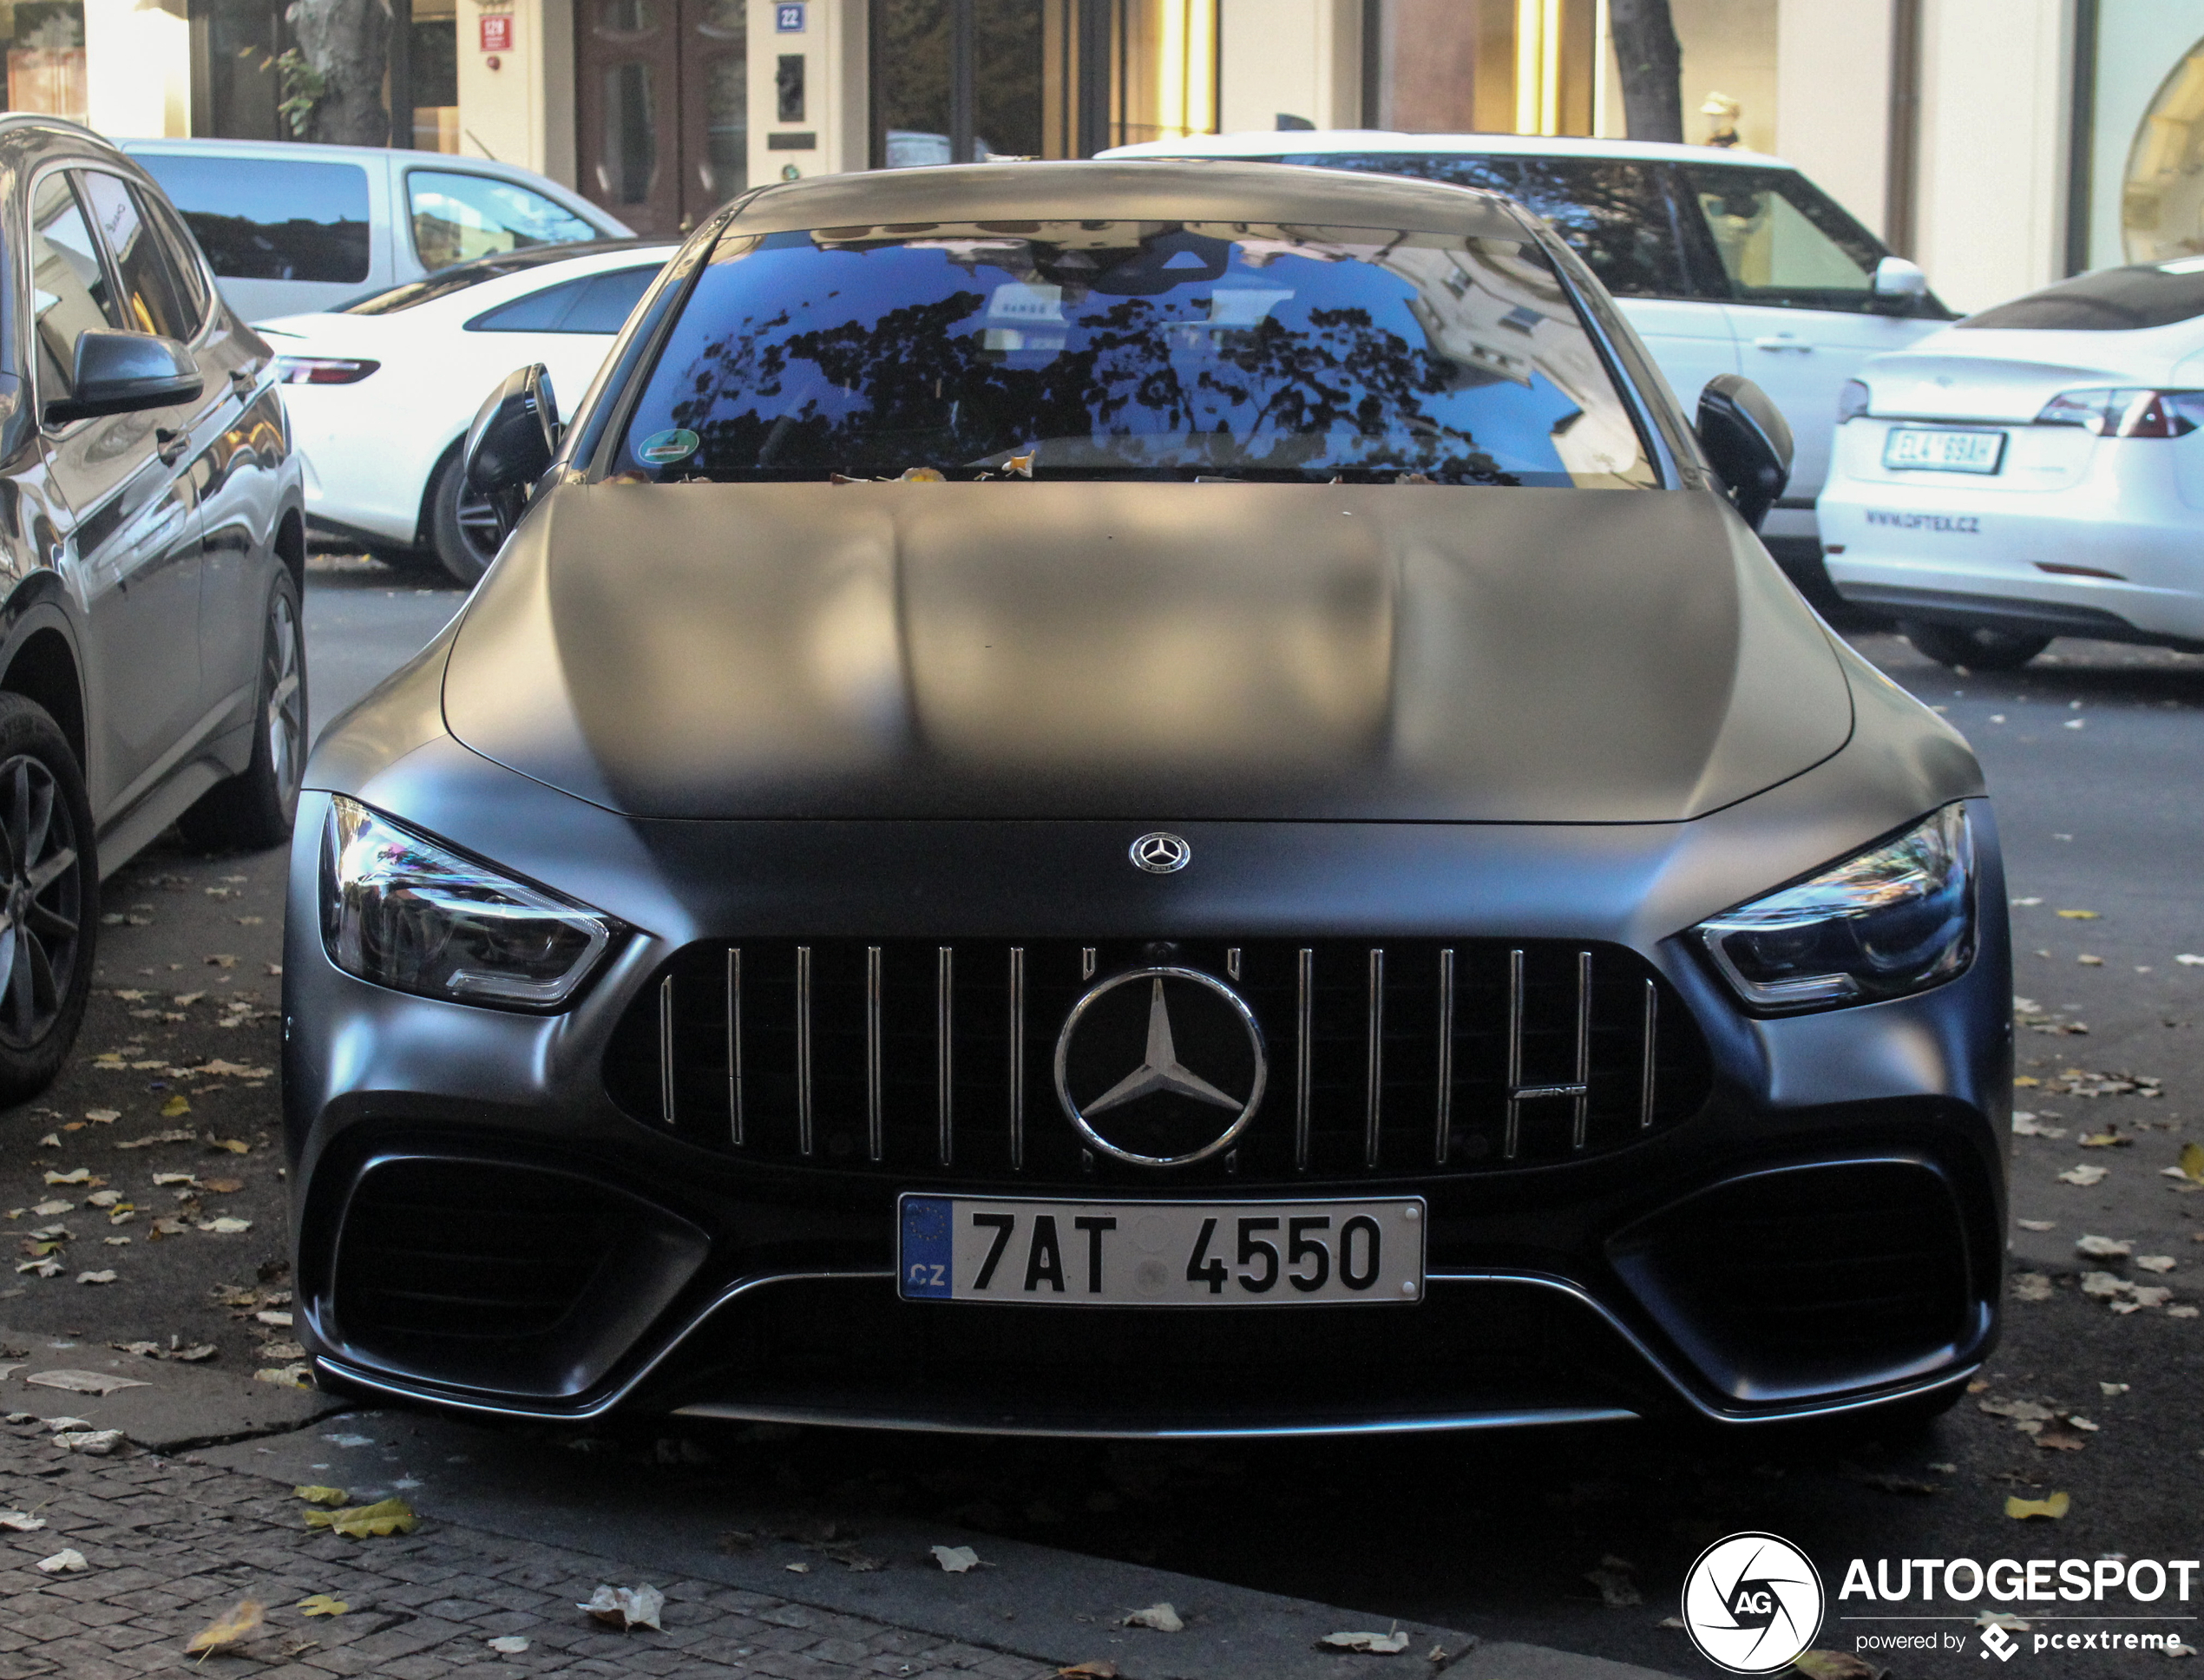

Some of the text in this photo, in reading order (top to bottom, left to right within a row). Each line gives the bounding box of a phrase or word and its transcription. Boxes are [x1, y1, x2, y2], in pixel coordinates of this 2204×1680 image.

[781, 9, 798, 27] 22
[973, 1212, 1381, 1294] 7AT 4550
[910, 1263, 945, 1286] CZ
